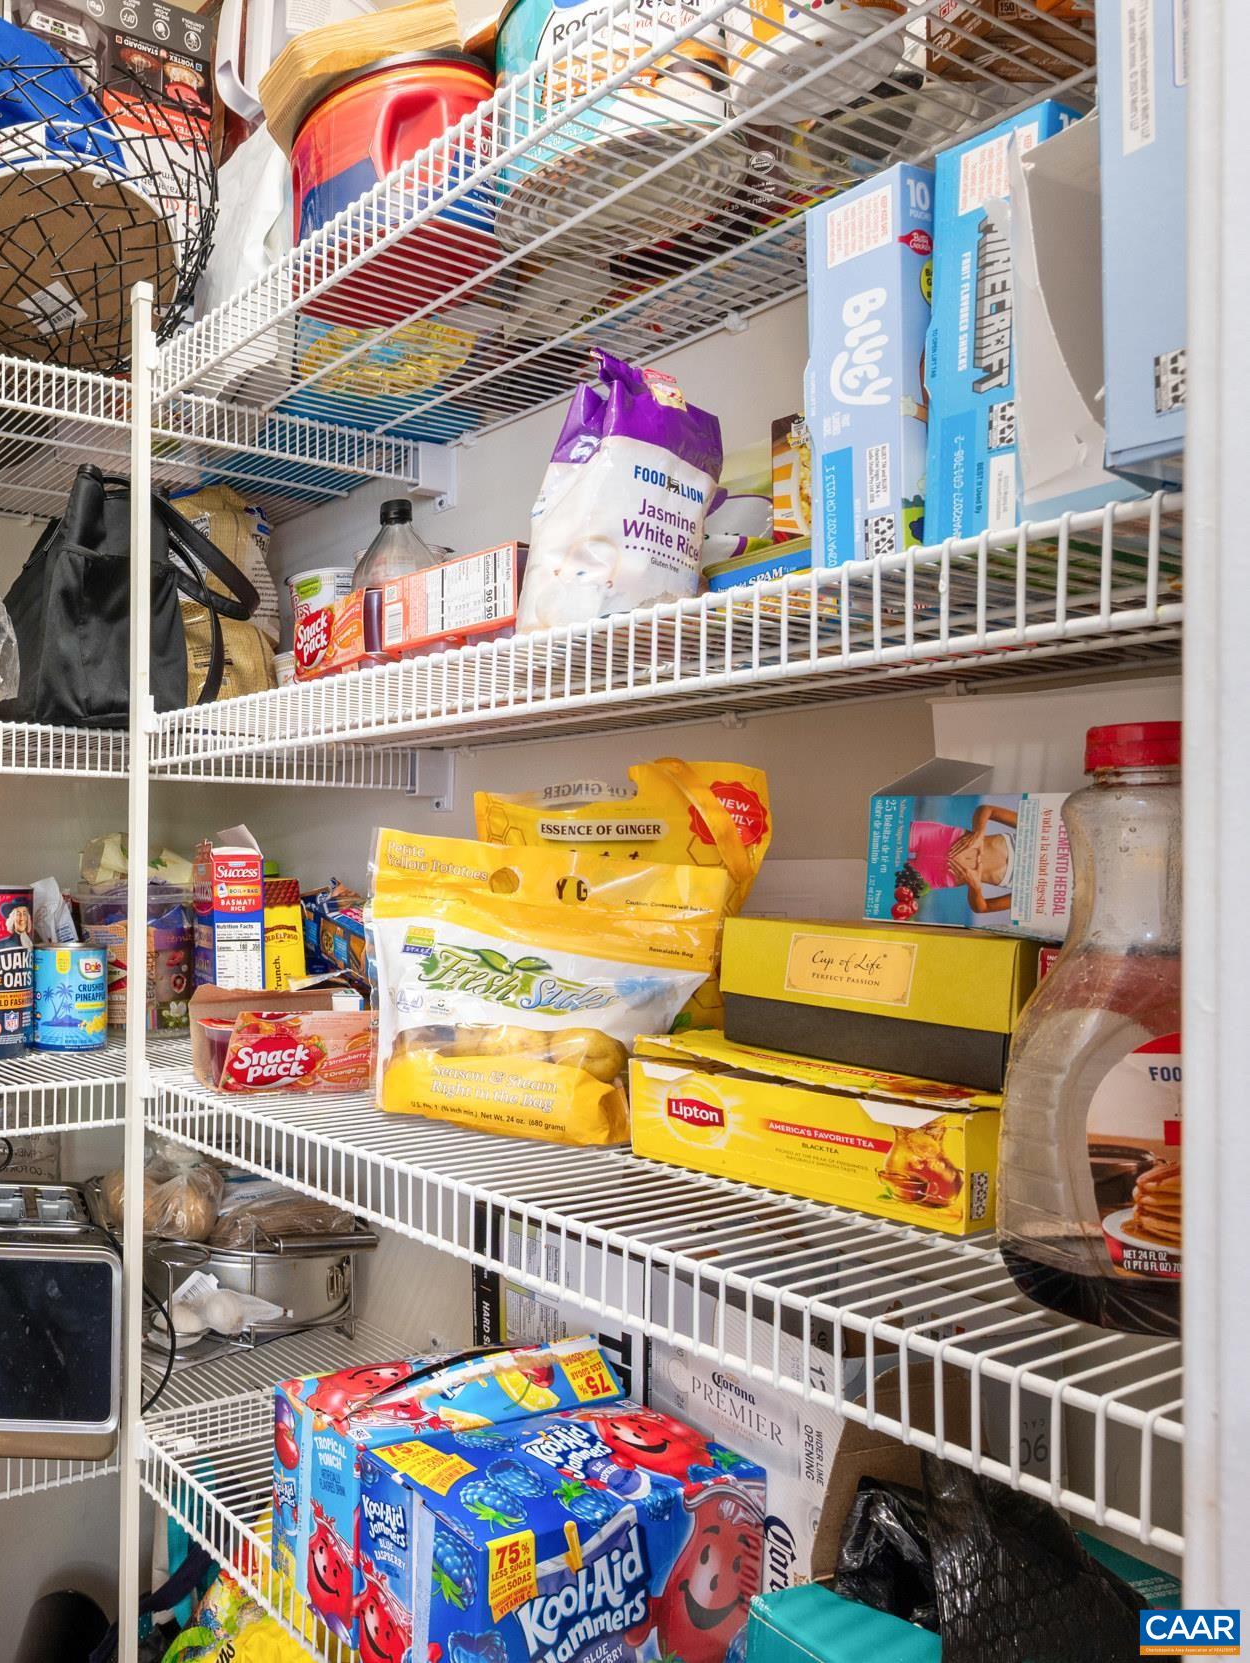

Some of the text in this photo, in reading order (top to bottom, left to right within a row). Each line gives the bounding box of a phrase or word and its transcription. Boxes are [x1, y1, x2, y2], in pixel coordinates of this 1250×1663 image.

[123, 38, 159, 56] STANDARD
[169, 54, 195, 69] VORTEX
[906, 177, 931, 211] 10
[633, 465, 704, 505] FOOD LION
[638, 498, 697, 535] Jasmine
[622, 518, 700, 562] White Rice
[650, 557, 680, 574] Gluten free
[748, 566, 784, 589] SPAM
[296, 611, 328, 649] Snack
[303, 632, 329, 663] pack
[874, 799, 884, 819] sobre
[1038, 807, 1054, 834] Ayuda
[541, 823, 661, 836] ESSENCE OF GINGER
[873, 819, 883, 830] de
[387, 840, 426, 858] Petite
[871, 830, 881, 864] aluminio
[1041, 843, 1050, 852] la
[216, 865, 259, 879] Success
[386, 853, 489, 882] Yellow Potatoes
[1038, 853, 1050, 877] salud
[1052, 817, 1071, 917] PLEMENTO HERBAL
[220, 899, 256, 907] BASMATI
[1034, 878, 1048, 915] digestiva
[84, 962, 101, 972] Dole
[811, 949, 883, 975] Cup of Life
[3, 971, 32, 988] OATS
[78, 983, 104, 993] CRUSHED
[418, 950, 520, 1002] Fresh
[812, 972, 880, 987] PERFECT PASSION
[233, 1045, 310, 1069] Snack
[245, 1060, 305, 1083] pack
[433, 1064, 558, 1093] Season & Steam
[431, 1079, 555, 1113] Right in the Bag
[480, 1111, 493, 1119] Net
[493, 1113, 504, 1122] Wt.
[515, 1117, 526, 1125] oz.
[528, 1118, 543, 1127] (680
[544, 1122, 566, 1132] grams)
[671, 1101, 719, 1123] Lipton
[768, 1121, 875, 1149] AMERICA'S FAVORITE TEA
[801, 1142, 839, 1155] BLACK TEA
[1123, 1249, 1167, 1262] NET 24 FL OZ
[1123, 1260, 1131, 1270] (1
[1131, 1260, 1142, 1270] PT
[1143, 1261, 1149, 1271] 8
[1150, 1261, 1159, 1272] FL
[1159, 1262, 1172, 1273] OZ)
[482, 1300, 491, 1327] HARD
[569, 1362, 604, 1381] LESS SUGAR
[711, 1371, 755, 1405] Corona
[691, 1375, 783, 1447] PREMIER
[313, 1435, 347, 1459] TROPICAL
[525, 1424, 590, 1467] Kool-Aid
[804, 1423, 815, 1481] OPENING
[317, 1450, 343, 1471] PUNCH
[563, 1441, 613, 1480] Jammers
[815, 1430, 824, 1487] WIDER LIME
[361, 1494, 405, 1531] Kool-Aid
[369, 1522, 406, 1549] Jammers
[378, 1539, 395, 1554] BLUE
[374, 1550, 406, 1571] RASPBERRY
[495, 1541, 530, 1570] 75%
[491, 1557, 531, 1582] LESS SUGAR
[507, 1572, 532, 1591] SODAS
[517, 1526, 644, 1655] Kool-Aid
[583, 1642, 609, 1663] BLUE
